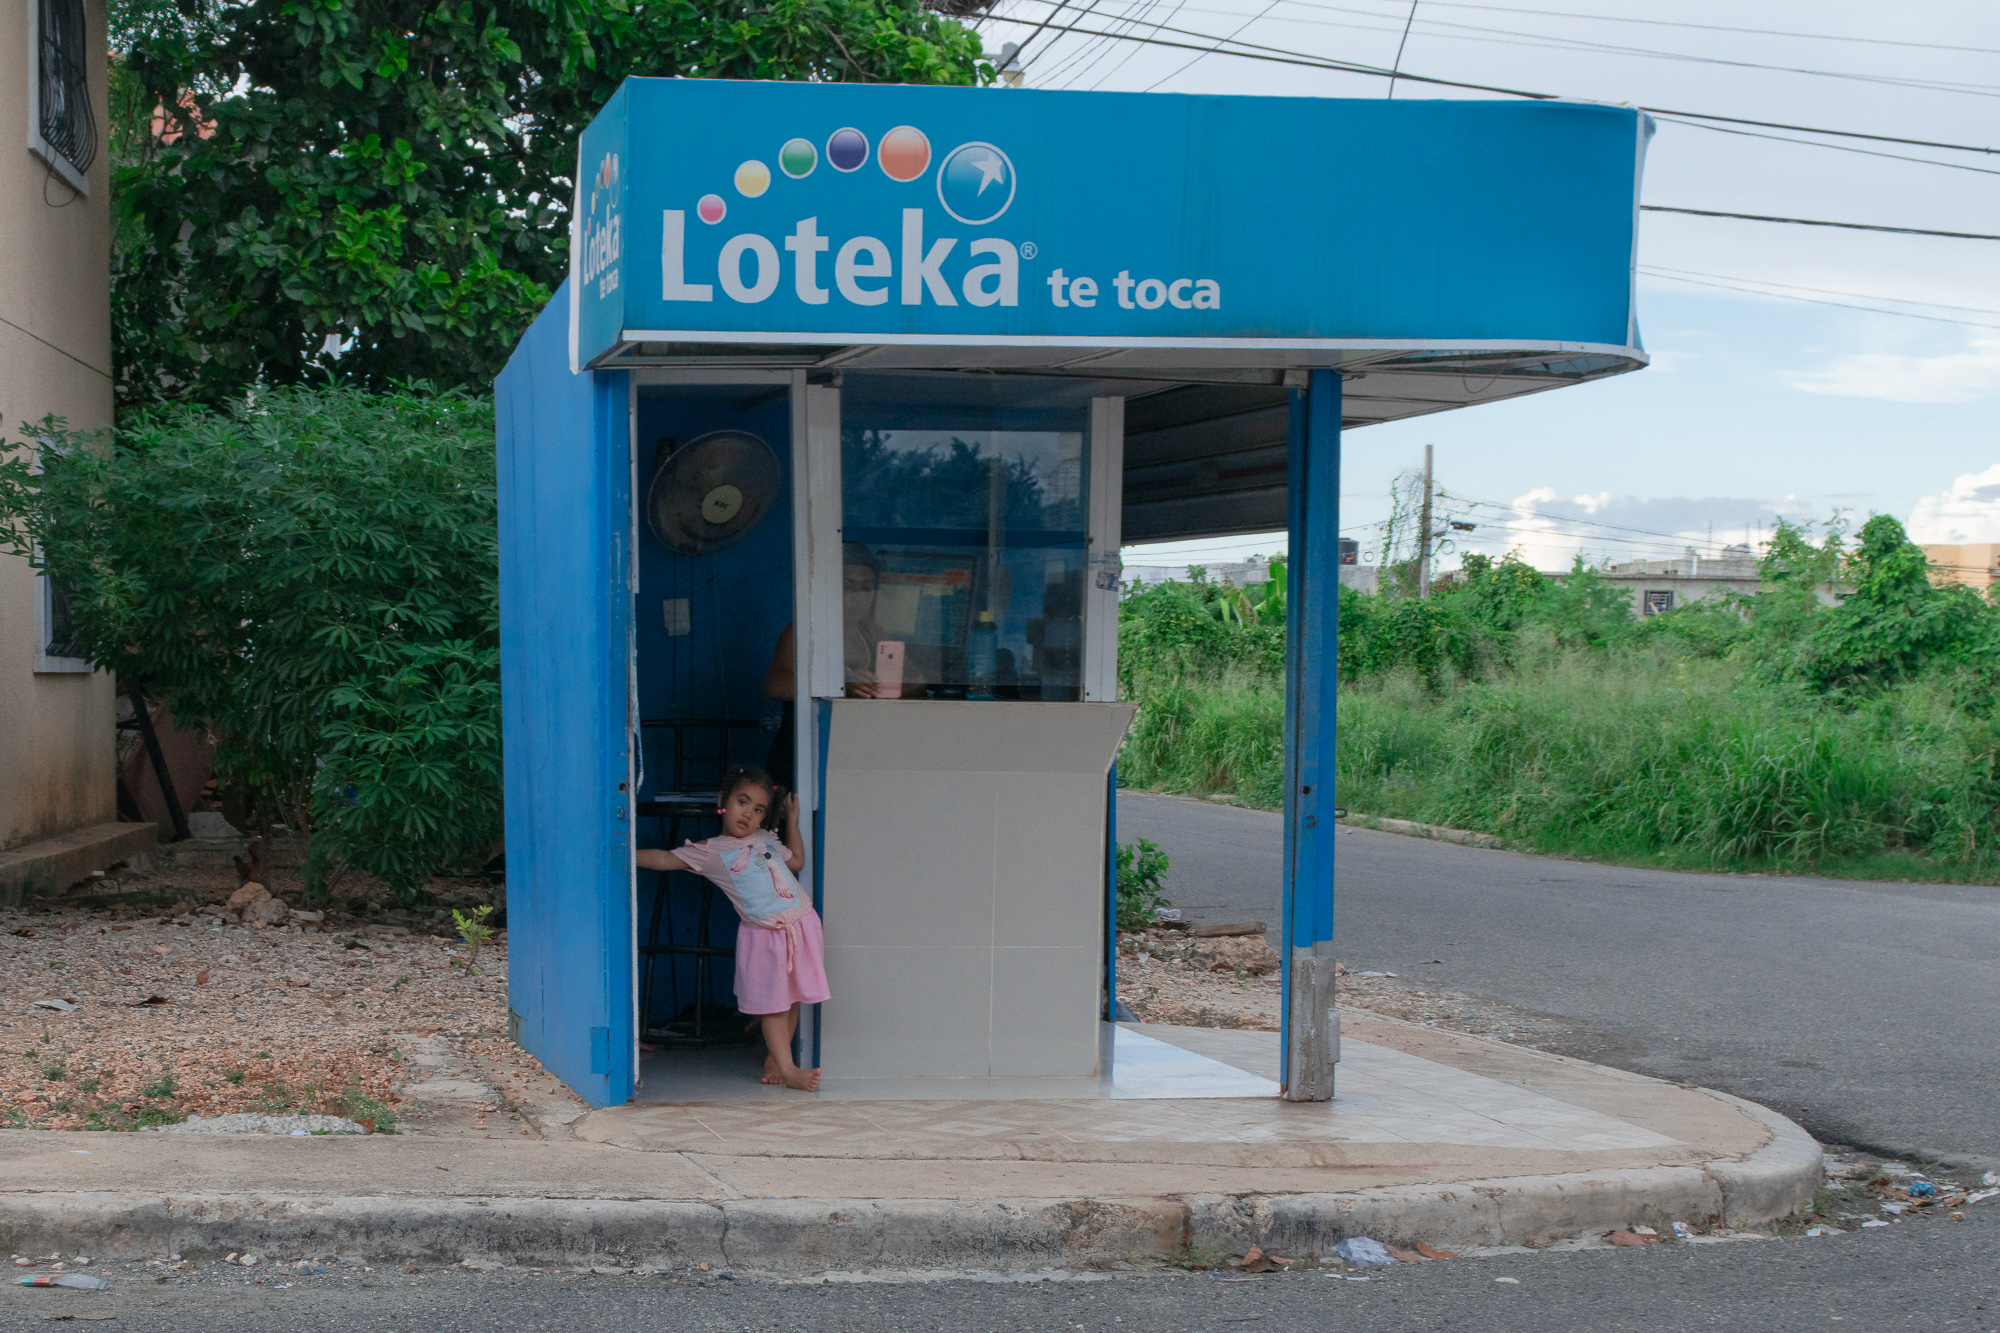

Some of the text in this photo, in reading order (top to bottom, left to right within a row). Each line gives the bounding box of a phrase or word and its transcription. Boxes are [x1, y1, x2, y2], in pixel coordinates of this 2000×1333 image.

[584, 203, 619, 286] Loteka
[1047, 268, 1099, 308] te
[1113, 270, 1221, 310] toca
